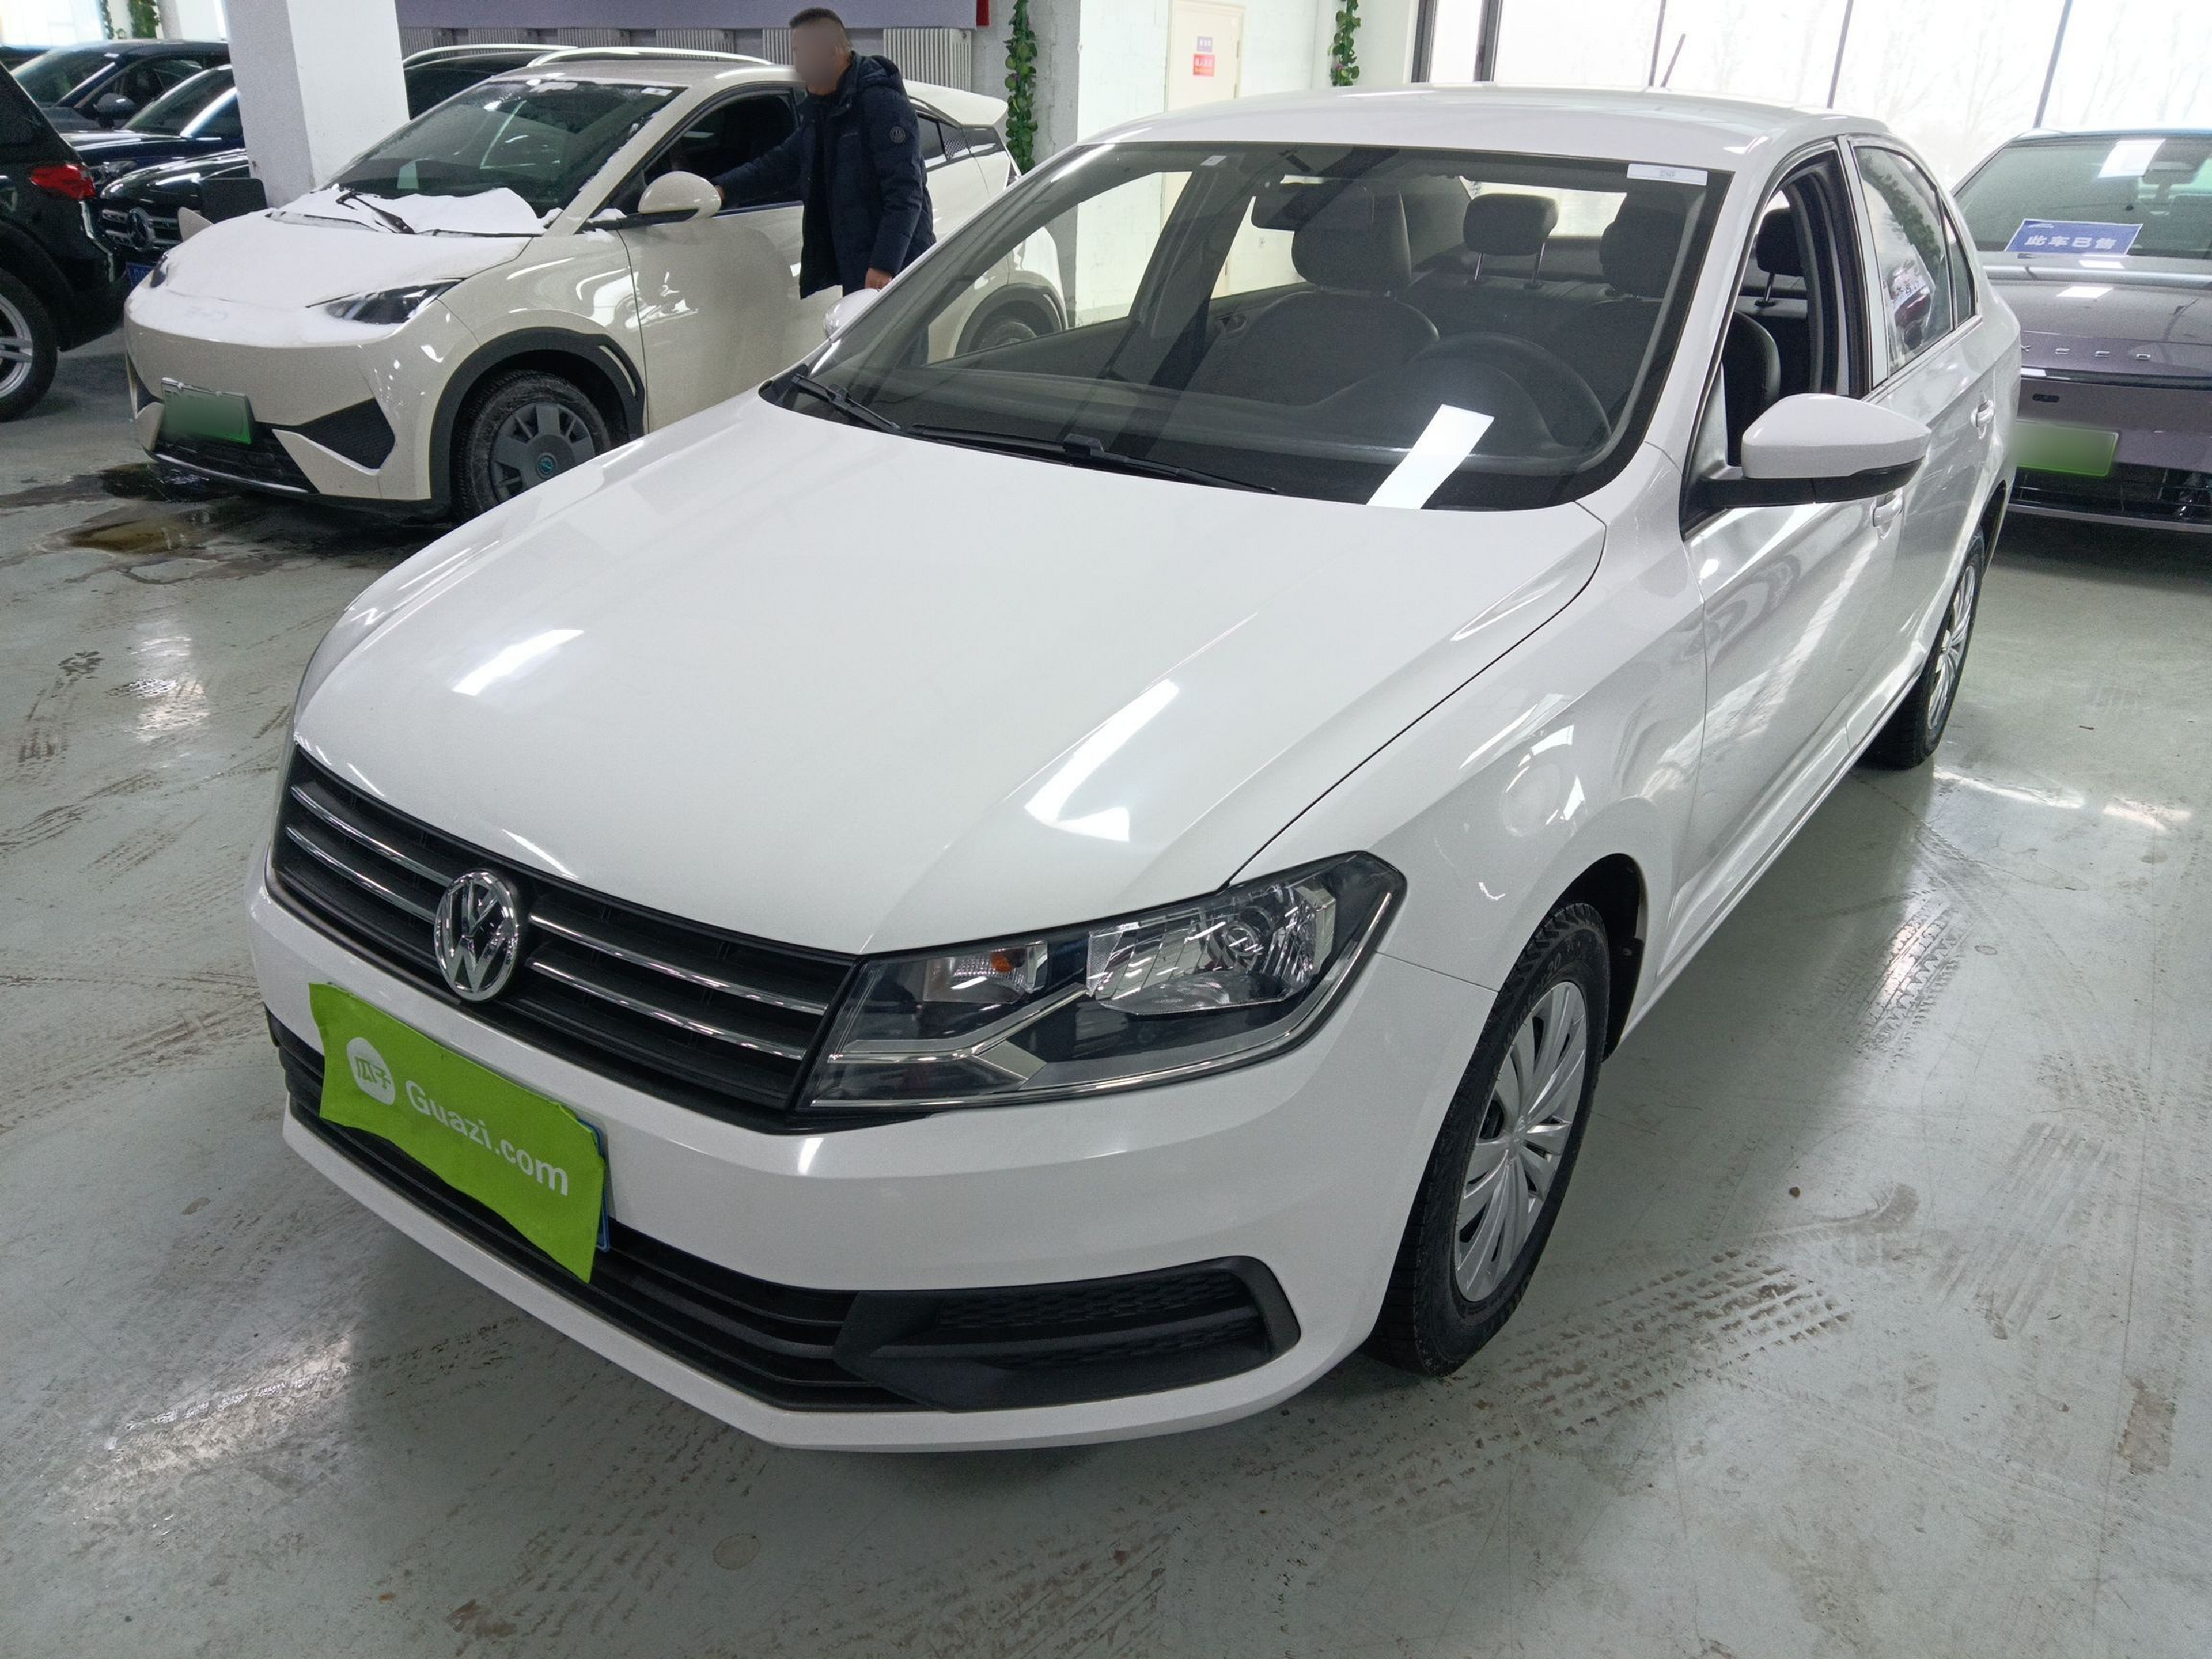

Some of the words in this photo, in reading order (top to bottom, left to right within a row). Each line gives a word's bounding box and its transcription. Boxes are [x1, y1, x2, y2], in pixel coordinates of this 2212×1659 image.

[2024, 235, 2118, 249] 此车已售
[435, 869, 518, 1001] VW
[354, 1055, 392, 1090] 瓜子
[406, 1080, 569, 1196] Guazi.com
